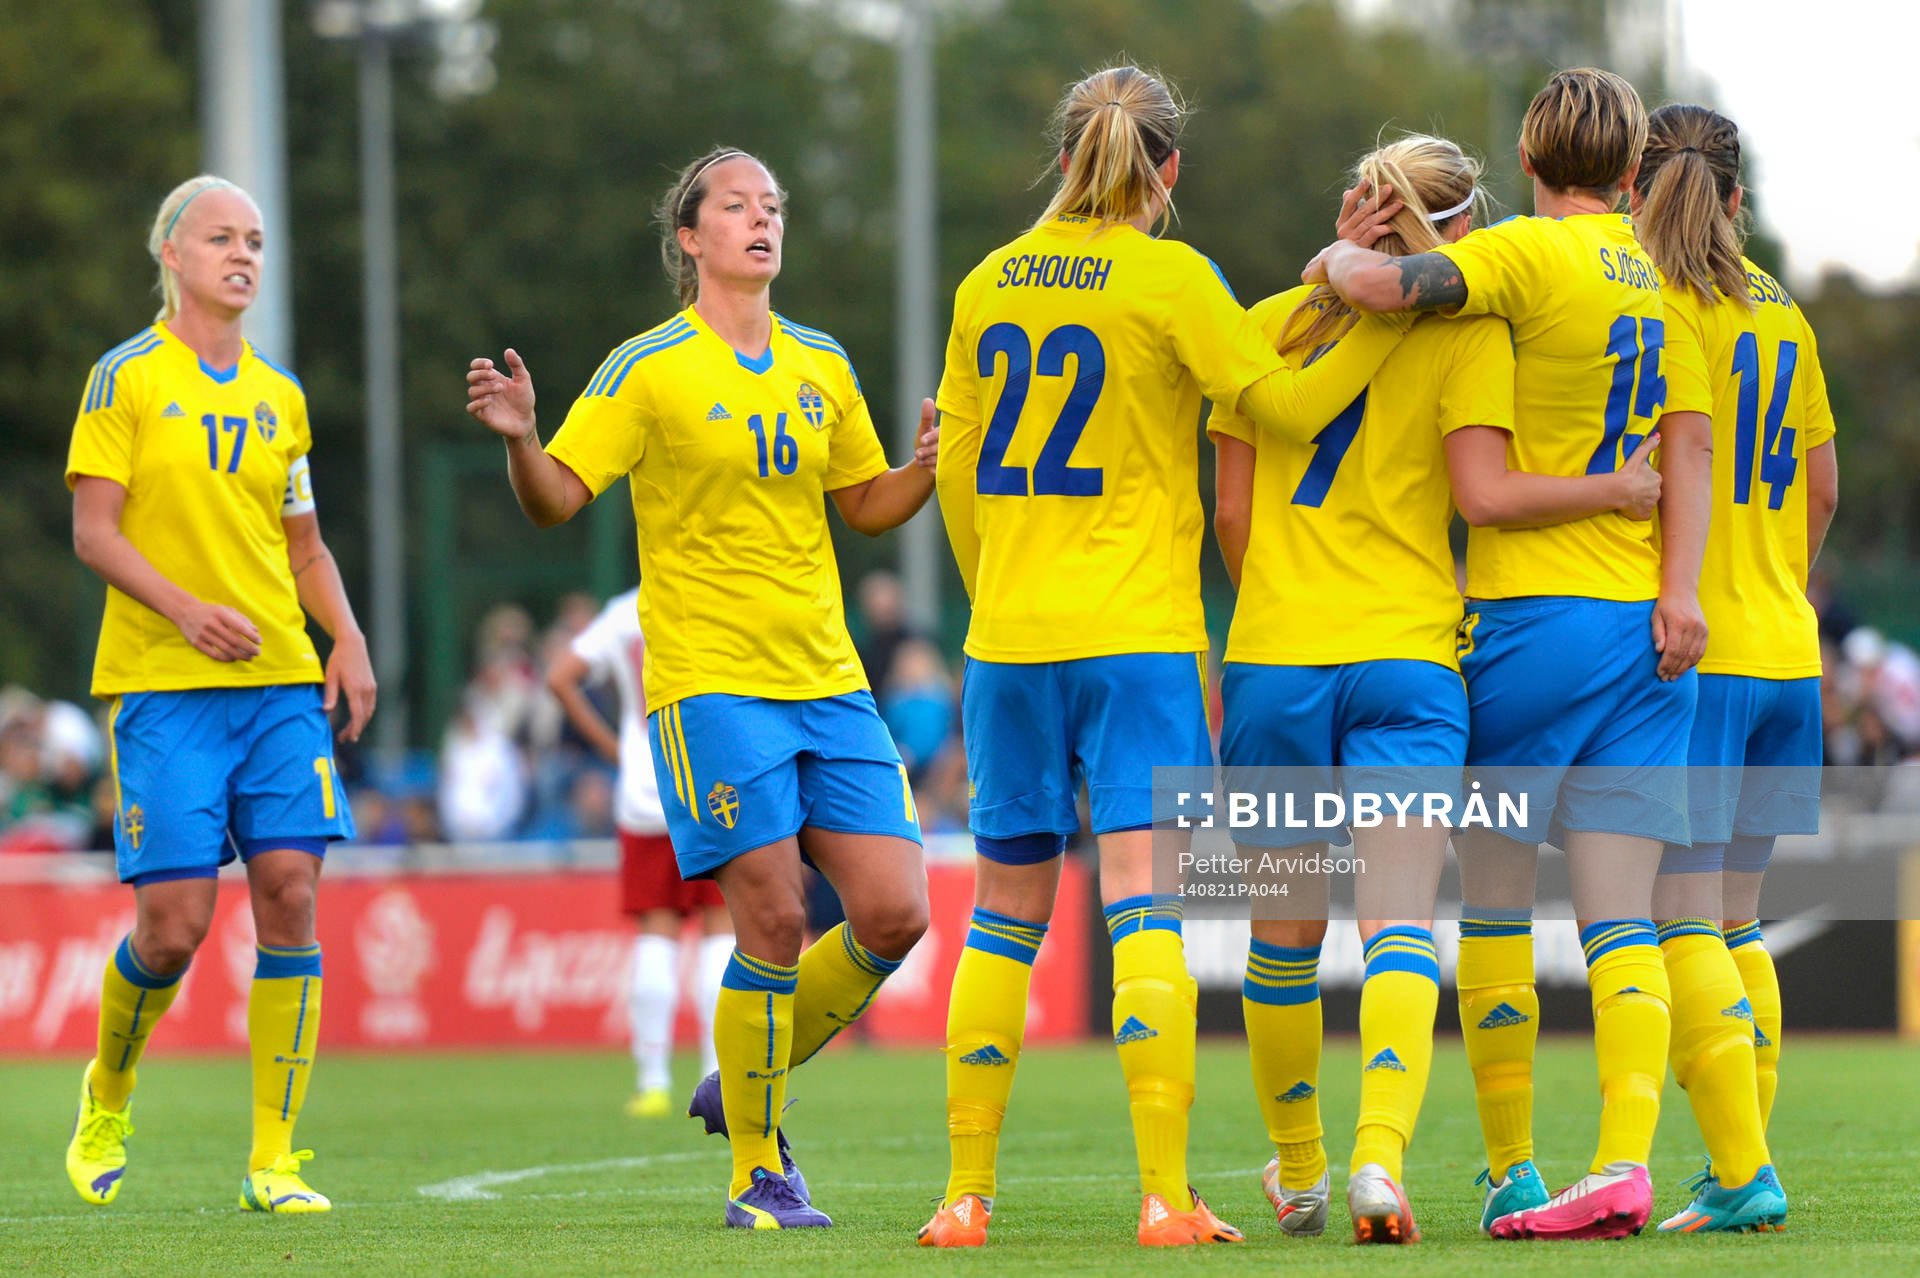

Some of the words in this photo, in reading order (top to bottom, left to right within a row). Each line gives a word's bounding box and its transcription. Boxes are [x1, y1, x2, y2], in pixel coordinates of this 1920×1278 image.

[997, 254, 1112, 290] SCHOUGH
[976, 322, 1106, 496] 22
[1731, 331, 1798, 511] 14
[201, 414, 248, 474] 17
[747, 412, 798, 478] 16
